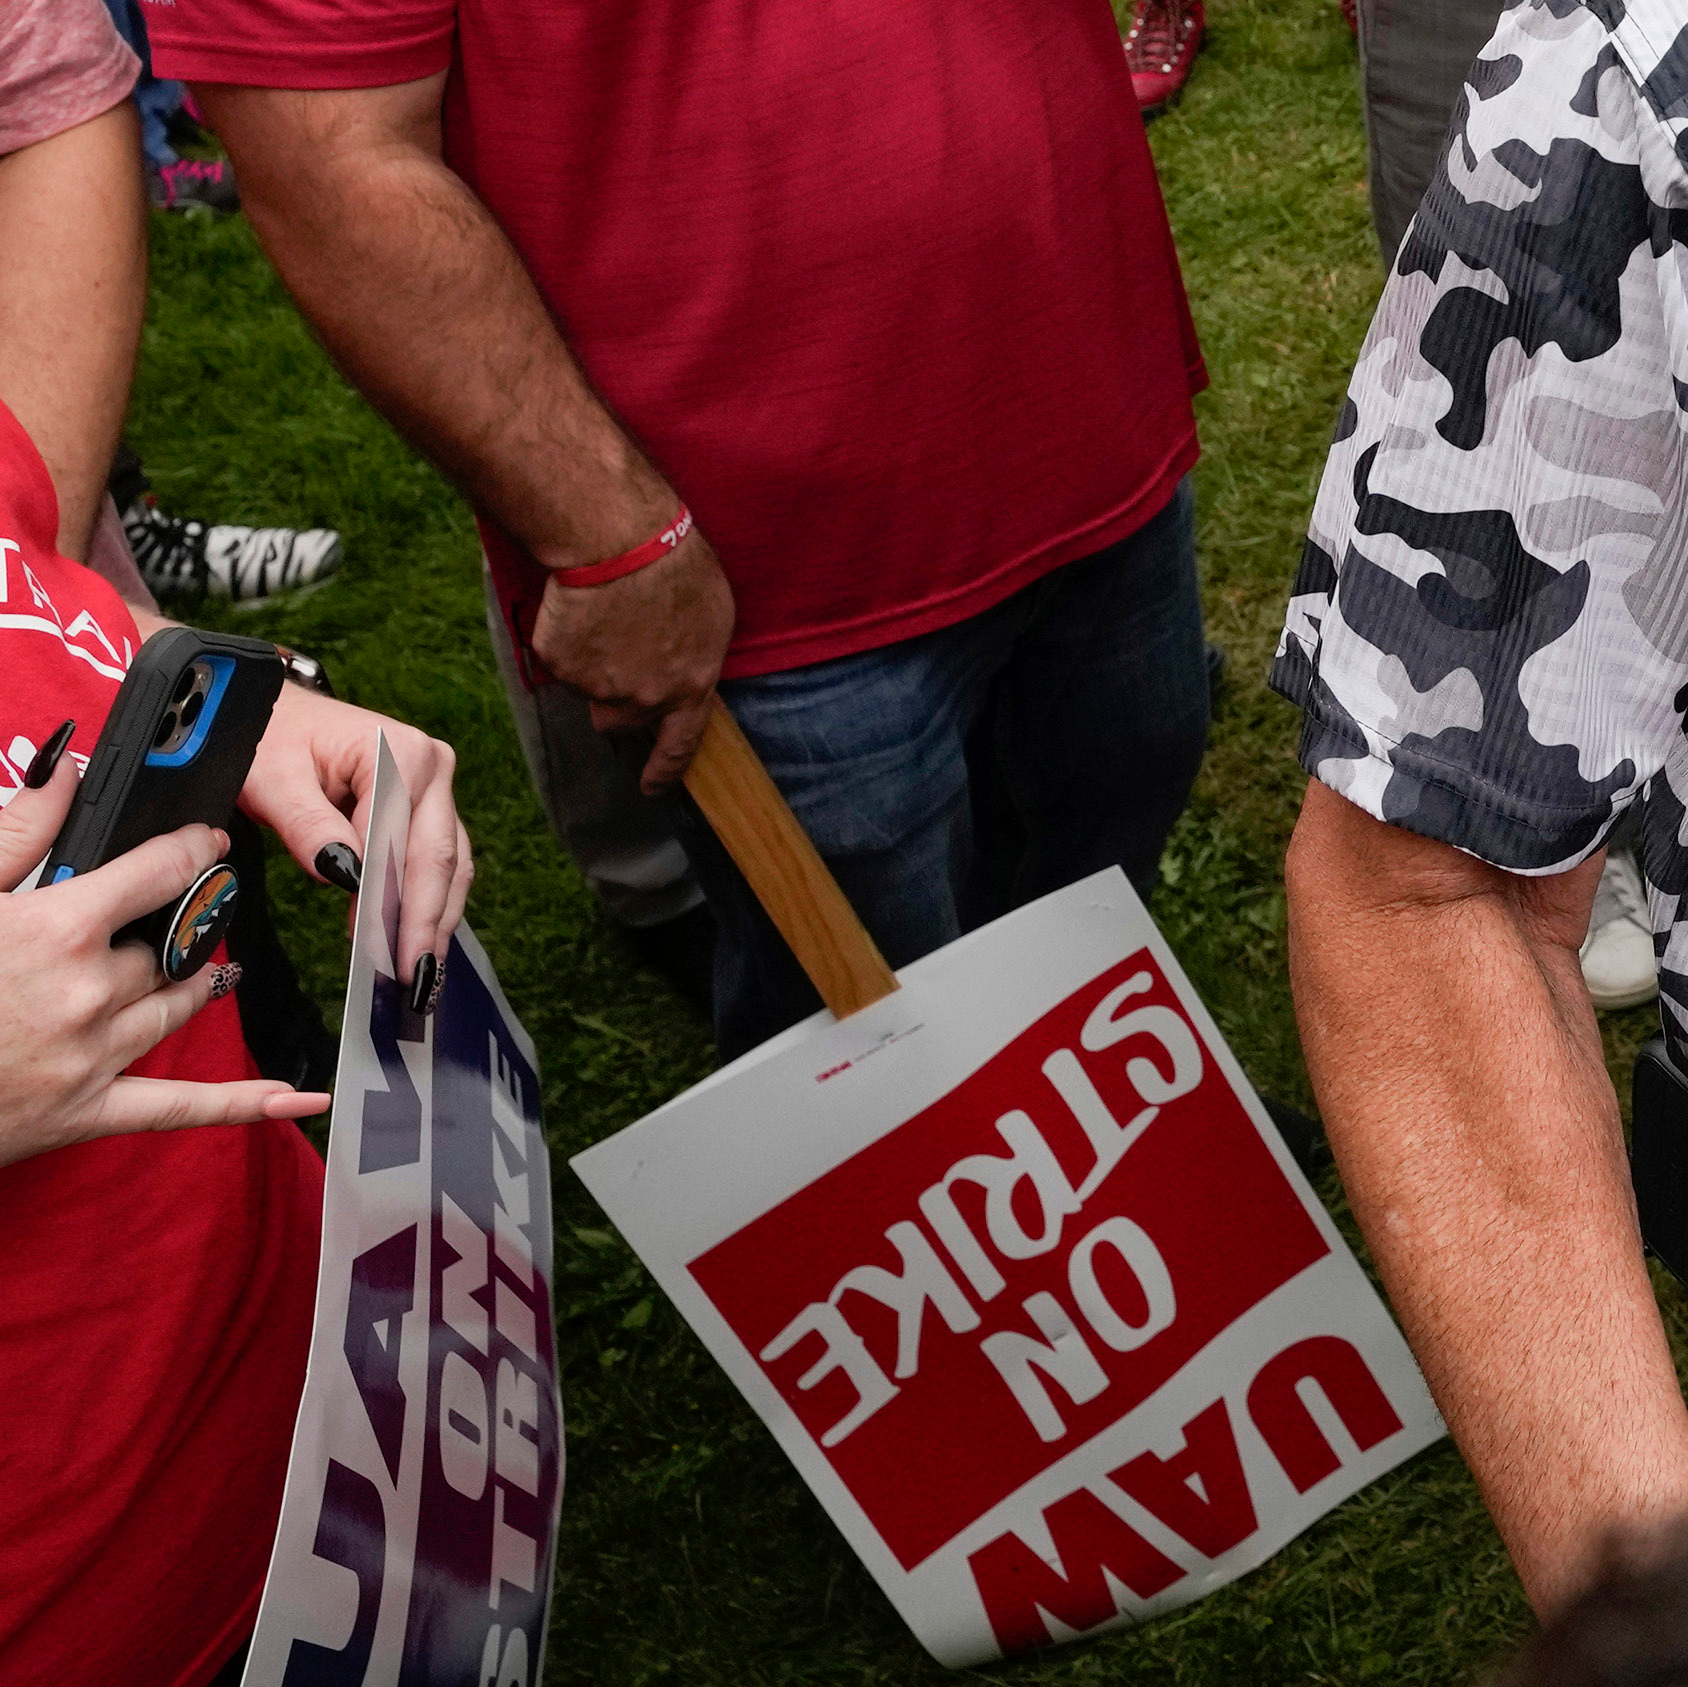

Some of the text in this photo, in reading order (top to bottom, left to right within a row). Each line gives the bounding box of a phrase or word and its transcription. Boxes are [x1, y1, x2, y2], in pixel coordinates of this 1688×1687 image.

[281, 834, 426, 1687] UAW
[440, 1190, 489, 1502] ON
[479, 1029, 538, 1687] STRIKE
[760, 970, 1203, 1449] STRIKE
[980, 1215, 1177, 1444] ON
[967, 1335, 1405, 1661] UAW
